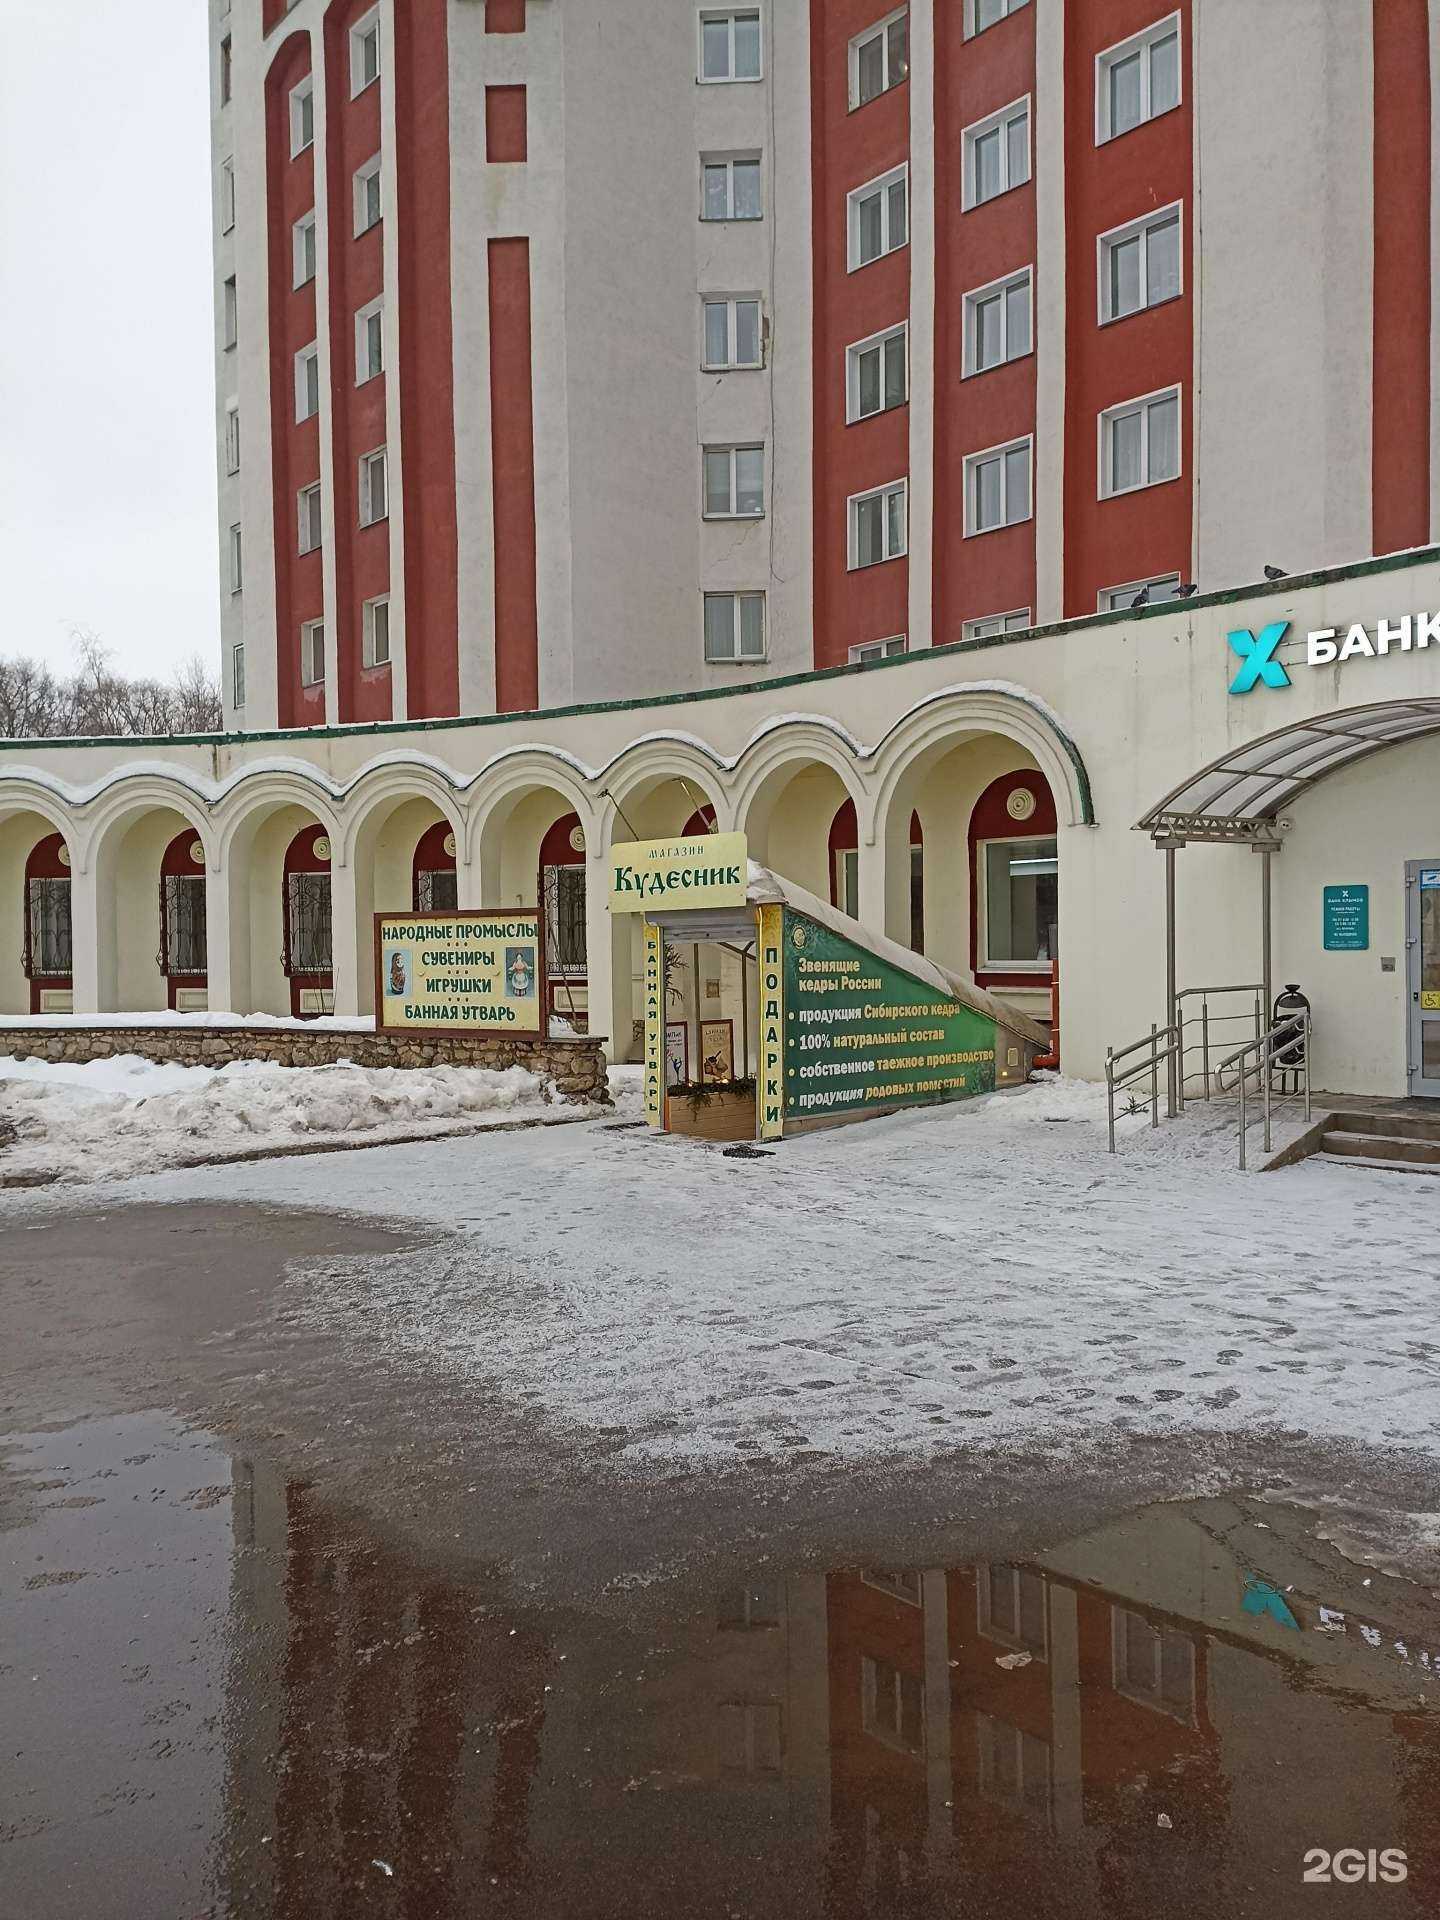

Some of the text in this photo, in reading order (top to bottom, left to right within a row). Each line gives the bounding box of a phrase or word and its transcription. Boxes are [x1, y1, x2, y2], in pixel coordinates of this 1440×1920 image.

[1307, 610, 1440, 666] БАНК
[383, 923, 538, 942] НАРОДНЫЕ ПРОМЫСЛЫ
[421, 951, 495, 966] СУВЕНИРЫ
[799, 957, 861, 974] Звенящие
[426, 978, 492, 993] ИГРУШКИ
[799, 976, 882, 994] кедры России
[404, 1004, 516, 1021] БАННАЯ УТВАРЬ
[799, 1003, 960, 1024] продукция Сибирского кедра
[647, 941, 658, 1112] БАННАЯ УТВАРЬ
[765, 947, 779, 1123] ПОДАРКИ
[799, 1027, 945, 1050] 100% натуральный состав
[799, 1049, 994, 1078] собственное таежное производство
[799, 1087, 864, 1108] продукция
[865, 1083, 914, 1101] родовых
